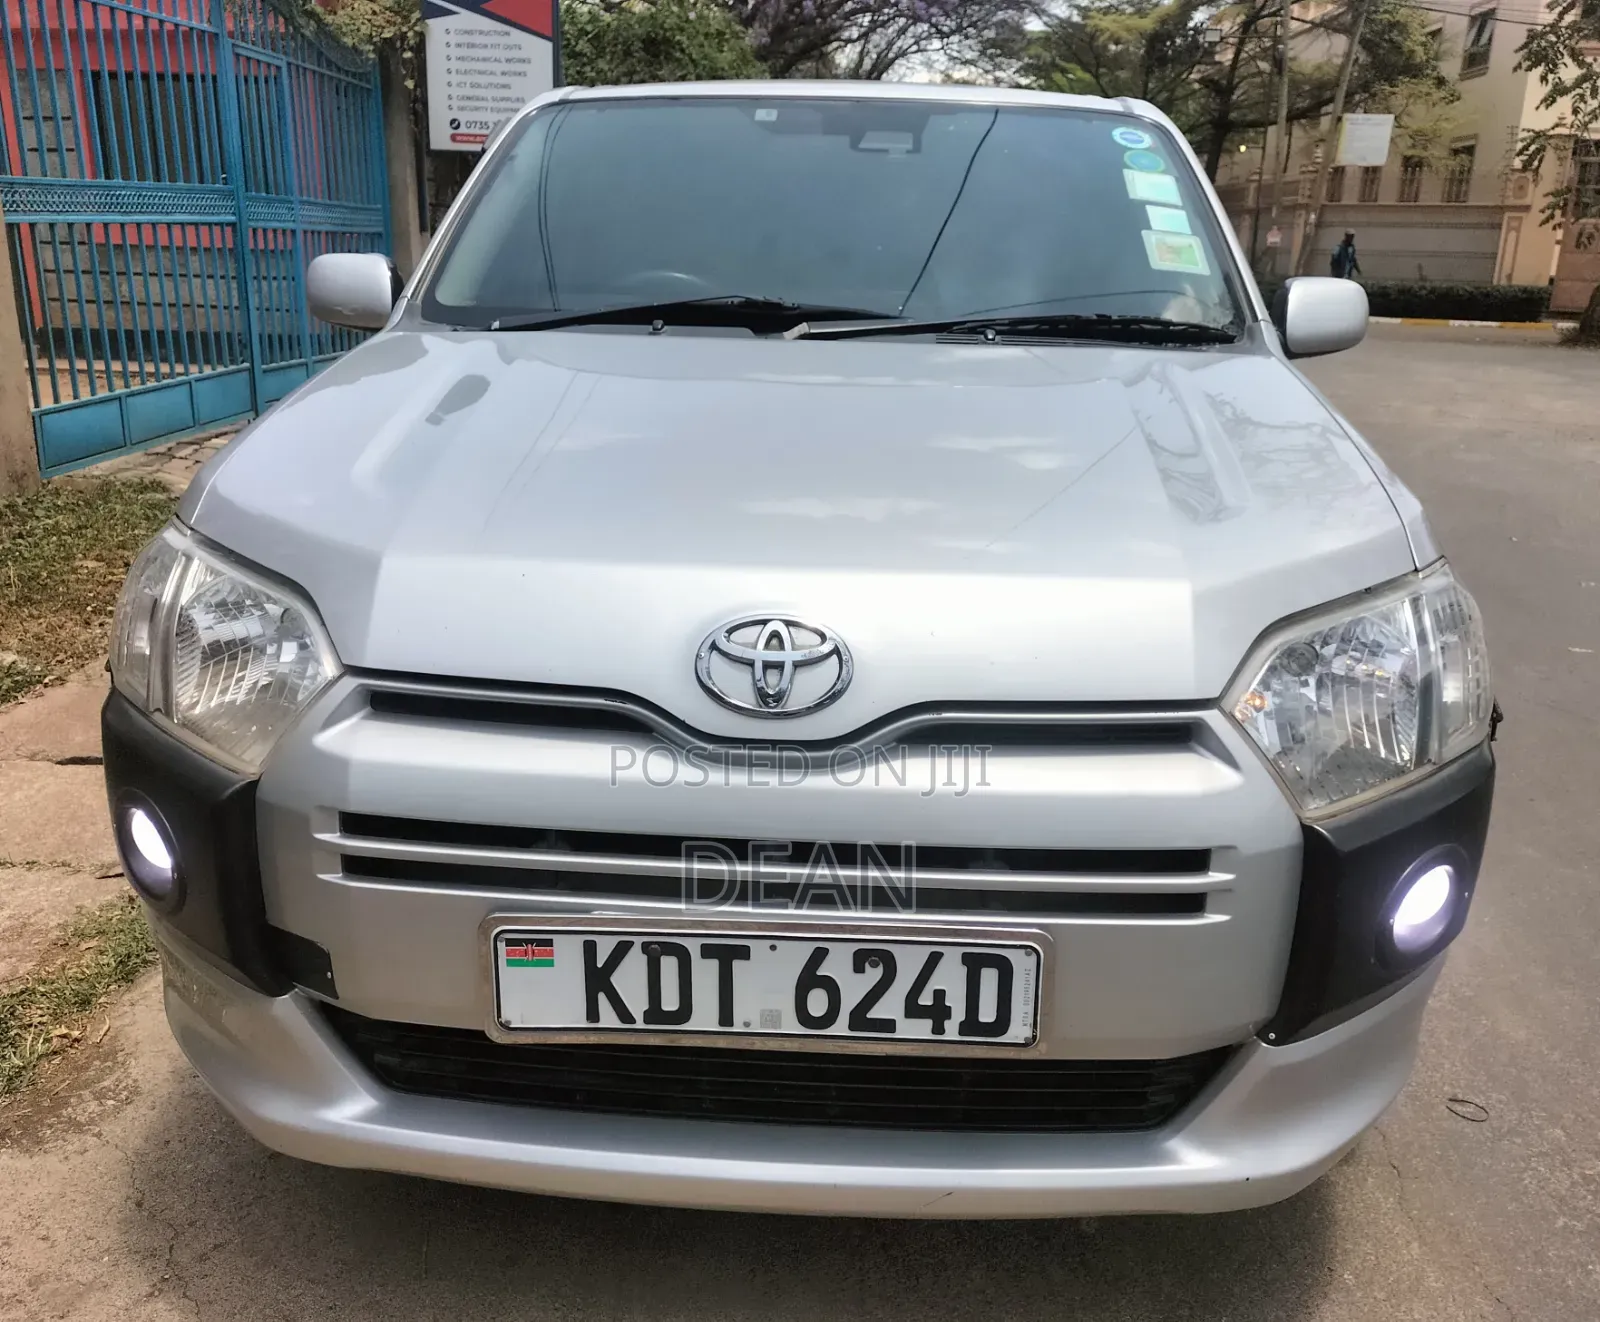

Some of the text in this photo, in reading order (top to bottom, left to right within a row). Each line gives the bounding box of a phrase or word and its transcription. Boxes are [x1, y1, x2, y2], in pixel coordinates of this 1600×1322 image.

[454, 28, 511, 37] CONSTRUCTION
[454, 42, 489, 50] INTERIOR
[455, 55, 532, 64] MECHANICAL WORKS
[455, 69, 498, 77] ELECTRICAL
[469, 82, 512, 90] SOLUTIONS
[456, 94, 490, 102] GENERAL
[457, 105, 489, 113] SECURITY
[465, 120, 490, 130] 0735
[582, 939, 1014, 1038] KDT 624D
